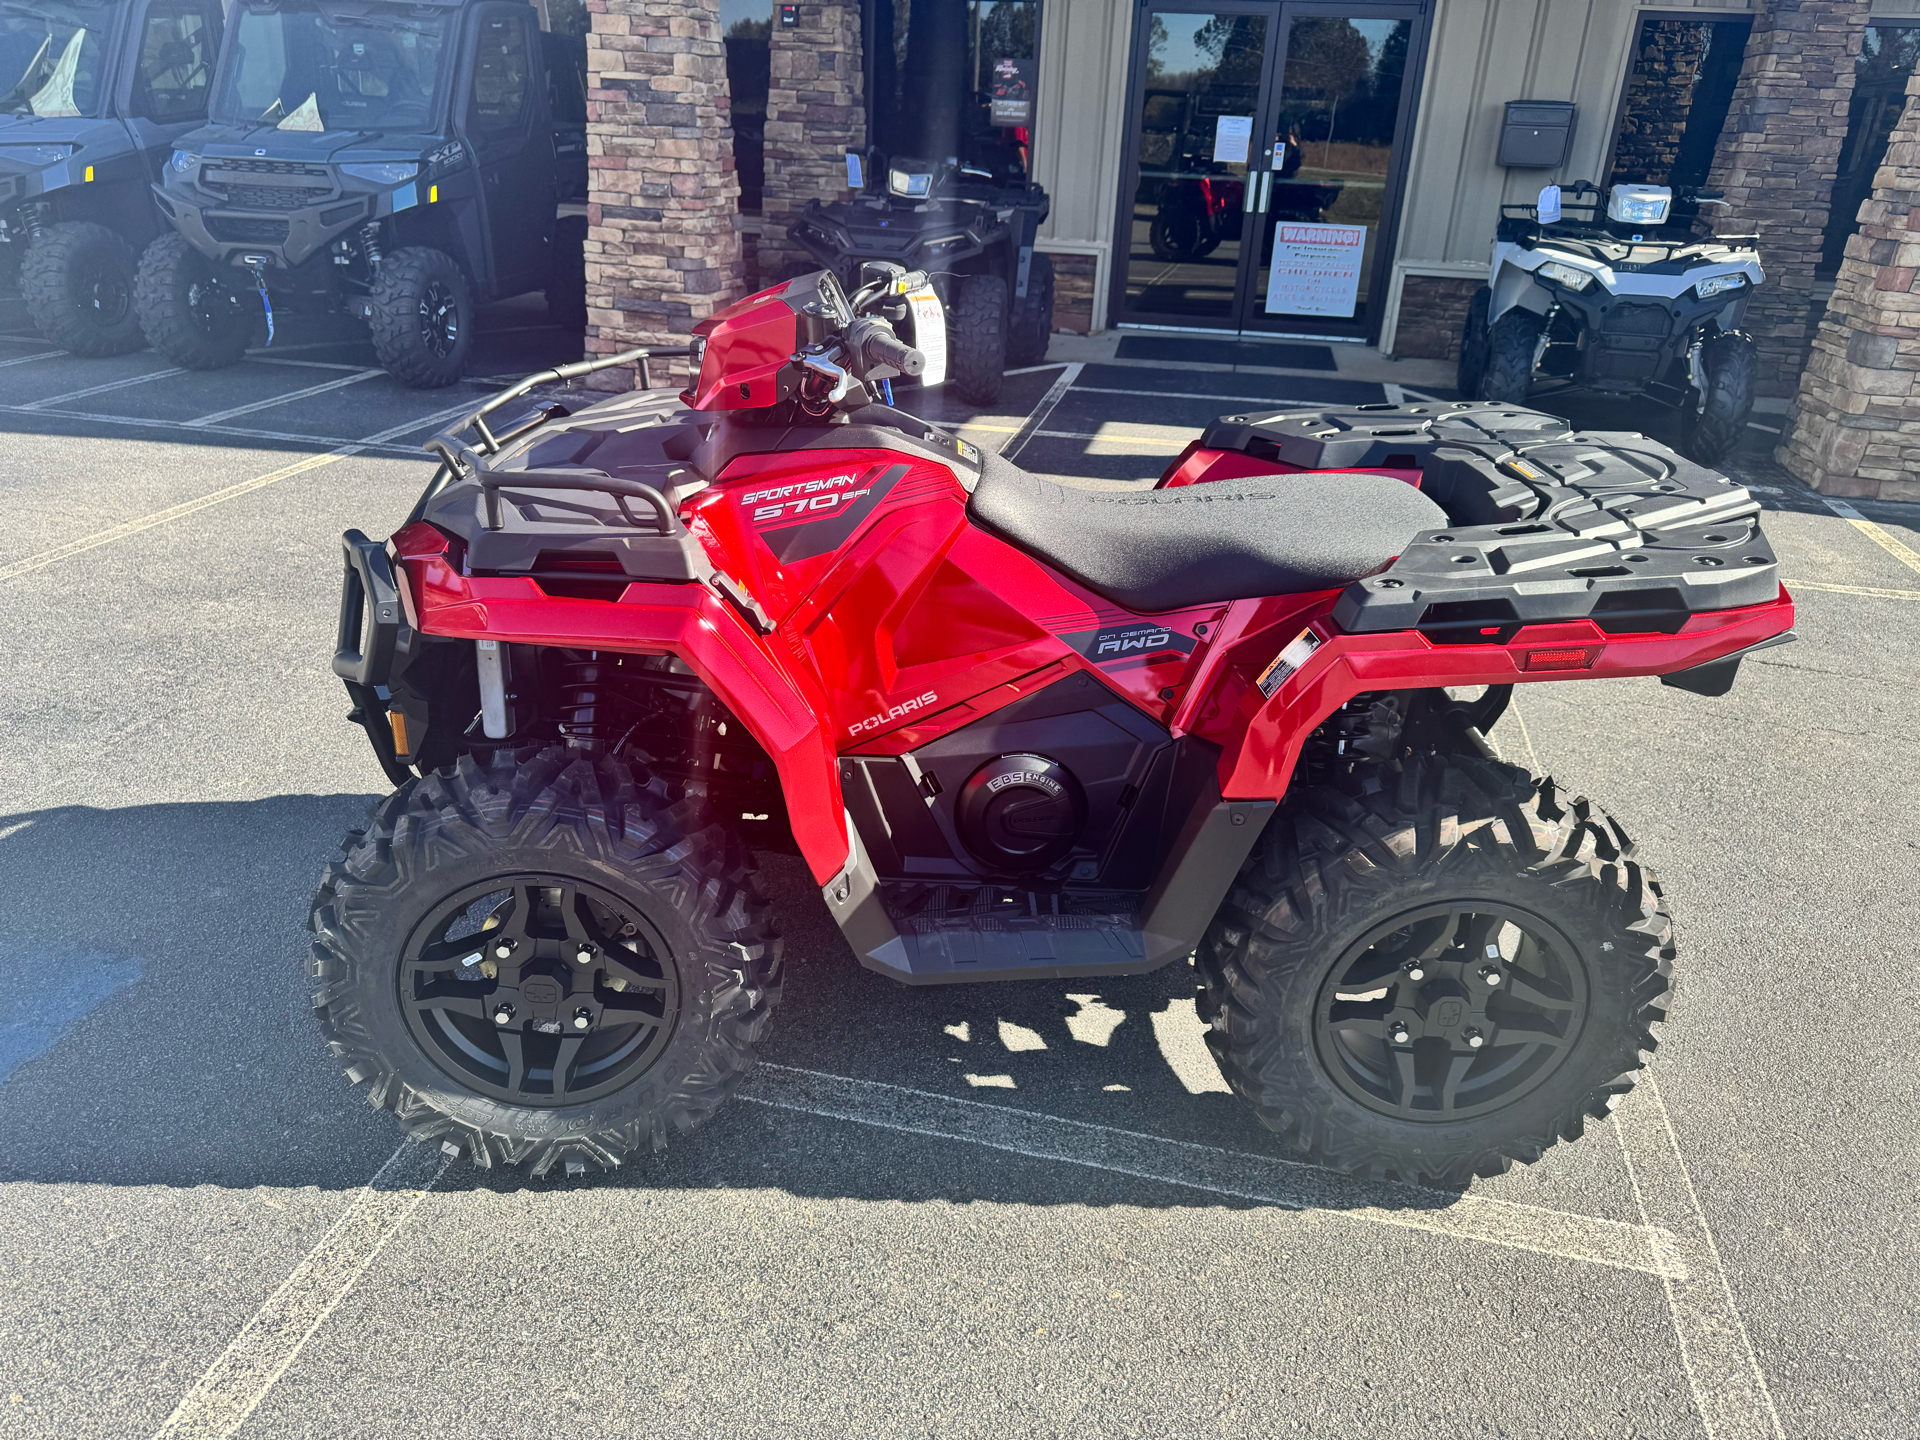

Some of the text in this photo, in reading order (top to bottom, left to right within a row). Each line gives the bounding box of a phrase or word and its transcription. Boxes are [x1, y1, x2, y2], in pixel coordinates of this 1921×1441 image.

[431, 141, 462, 162] XP
[443, 152, 463, 166] 1000
[1282, 227, 1360, 245] WARNING!
[1304, 245, 1351, 253] Insurance
[1278, 268, 1354, 278] CHILDREN
[741, 472, 858, 506] SPORTSMAN
[753, 488, 871, 522] 570 EFI
[1097, 633, 1170, 654] AWD
[1098, 626, 1172, 641] ON DEMAND
[847, 689, 938, 737] POLARIS
[990, 772, 1022, 790] EBS
[1025, 772, 1062, 792] ENGINE
